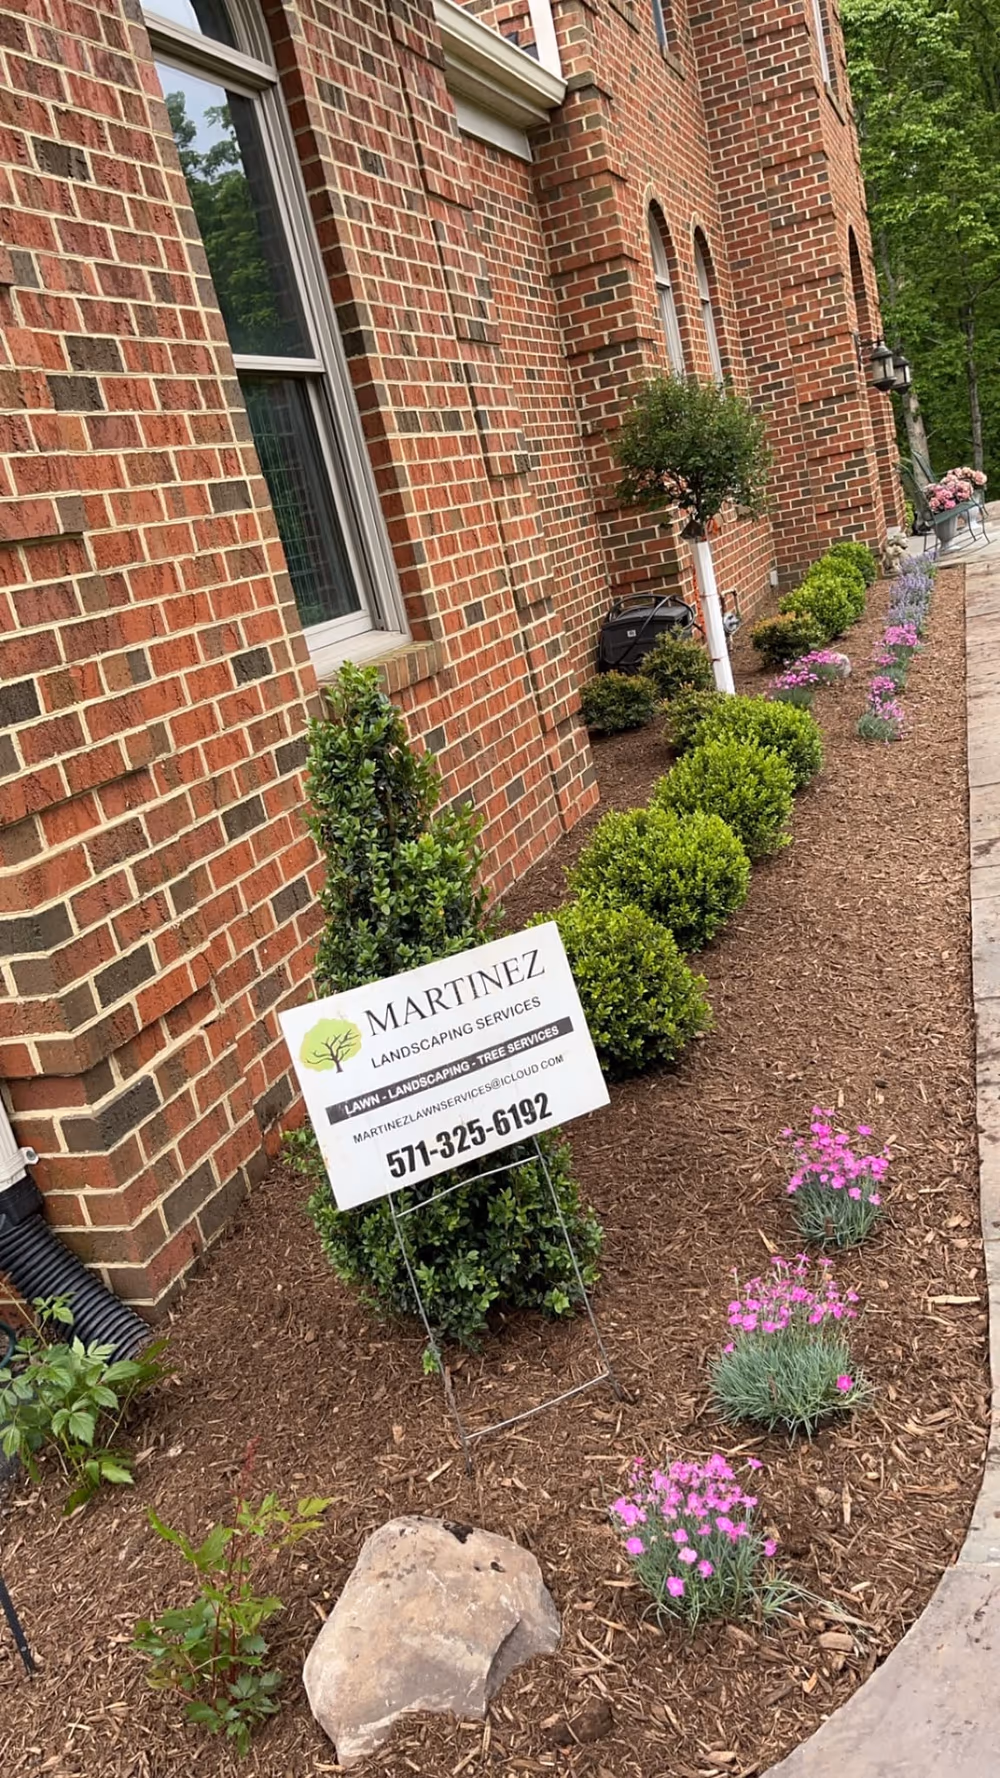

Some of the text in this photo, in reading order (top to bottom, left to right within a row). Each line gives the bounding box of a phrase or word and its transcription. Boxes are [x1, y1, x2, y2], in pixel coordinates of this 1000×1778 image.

[364, 949, 545, 1037] MARTINEZ
[371, 995, 542, 1069] LANDSCAPING SERVICES
[344, 1093, 380, 1115] LAWN
[388, 1061, 471, 1100] LANDSCAPING
[478, 1045, 507, 1065] TREE
[507, 1025, 559, 1053] SERVICES
[352, 1054, 565, 1144] MARTINEZLAWNSERVICES@ICLOUDCOM
[386, 1092, 553, 1179] 571-325-6192
